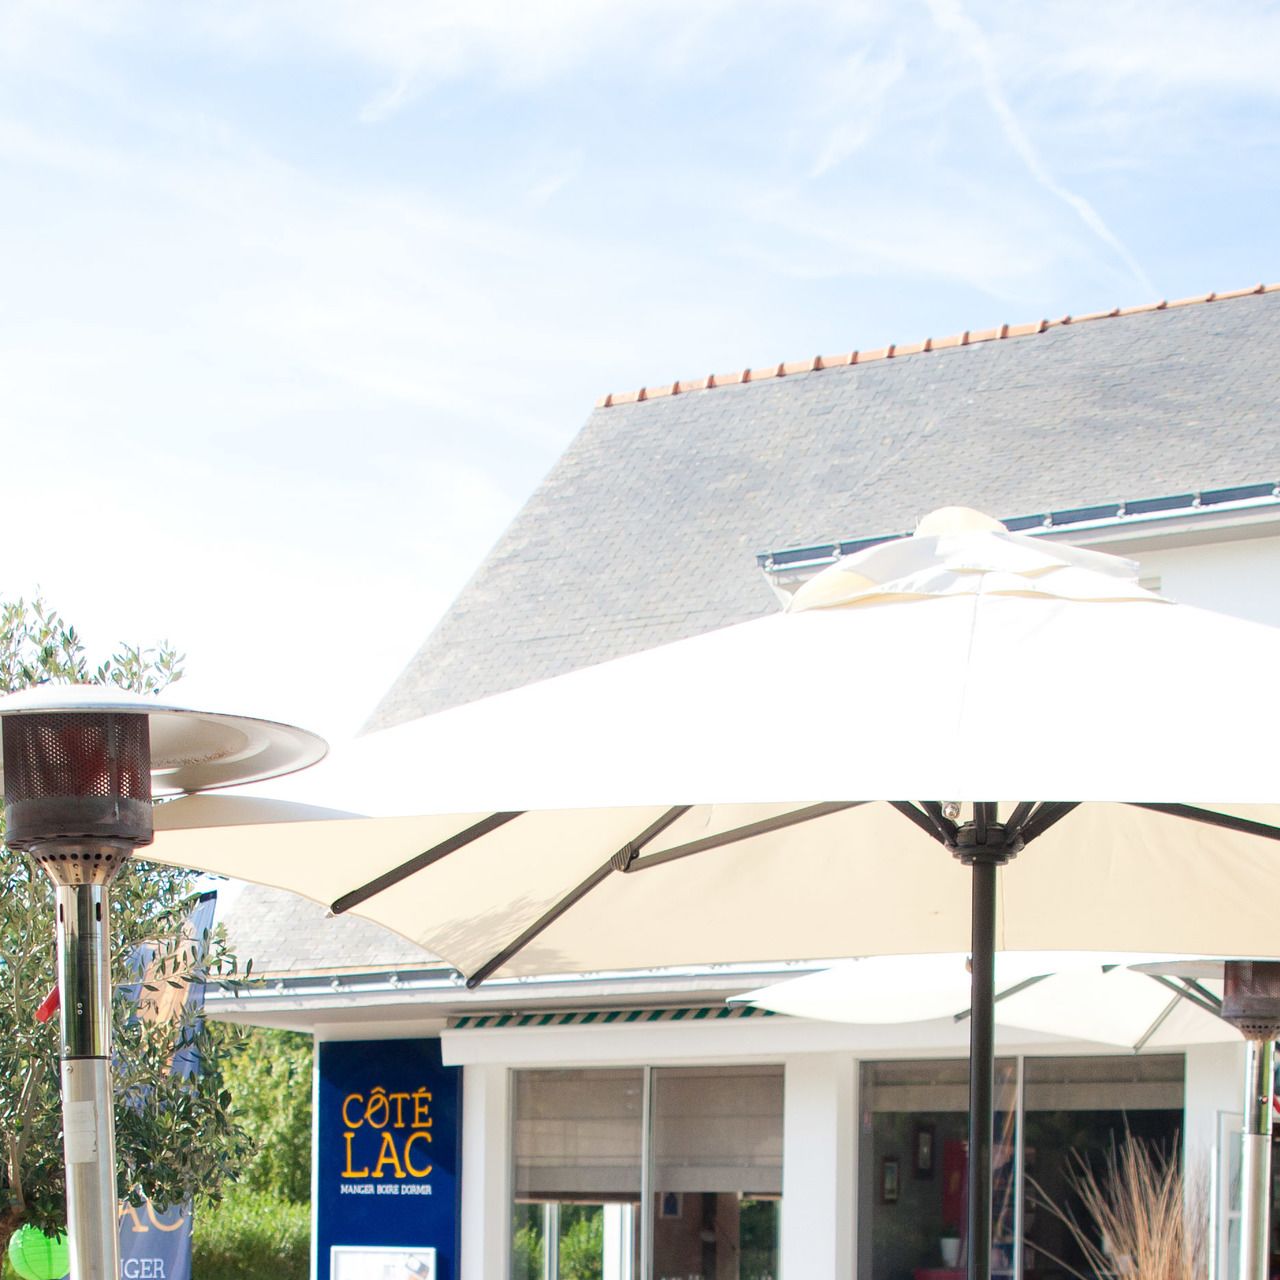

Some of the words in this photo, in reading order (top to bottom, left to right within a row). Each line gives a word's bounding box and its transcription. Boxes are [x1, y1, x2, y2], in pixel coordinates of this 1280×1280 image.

[342, 1086, 432, 1129] CÔTÉ
[341, 1131, 432, 1178] LAC
[340, 1184, 375, 1195] MANGER
[376, 1184, 400, 1195] BOIRE
[401, 1184, 432, 1195] DORMIR
